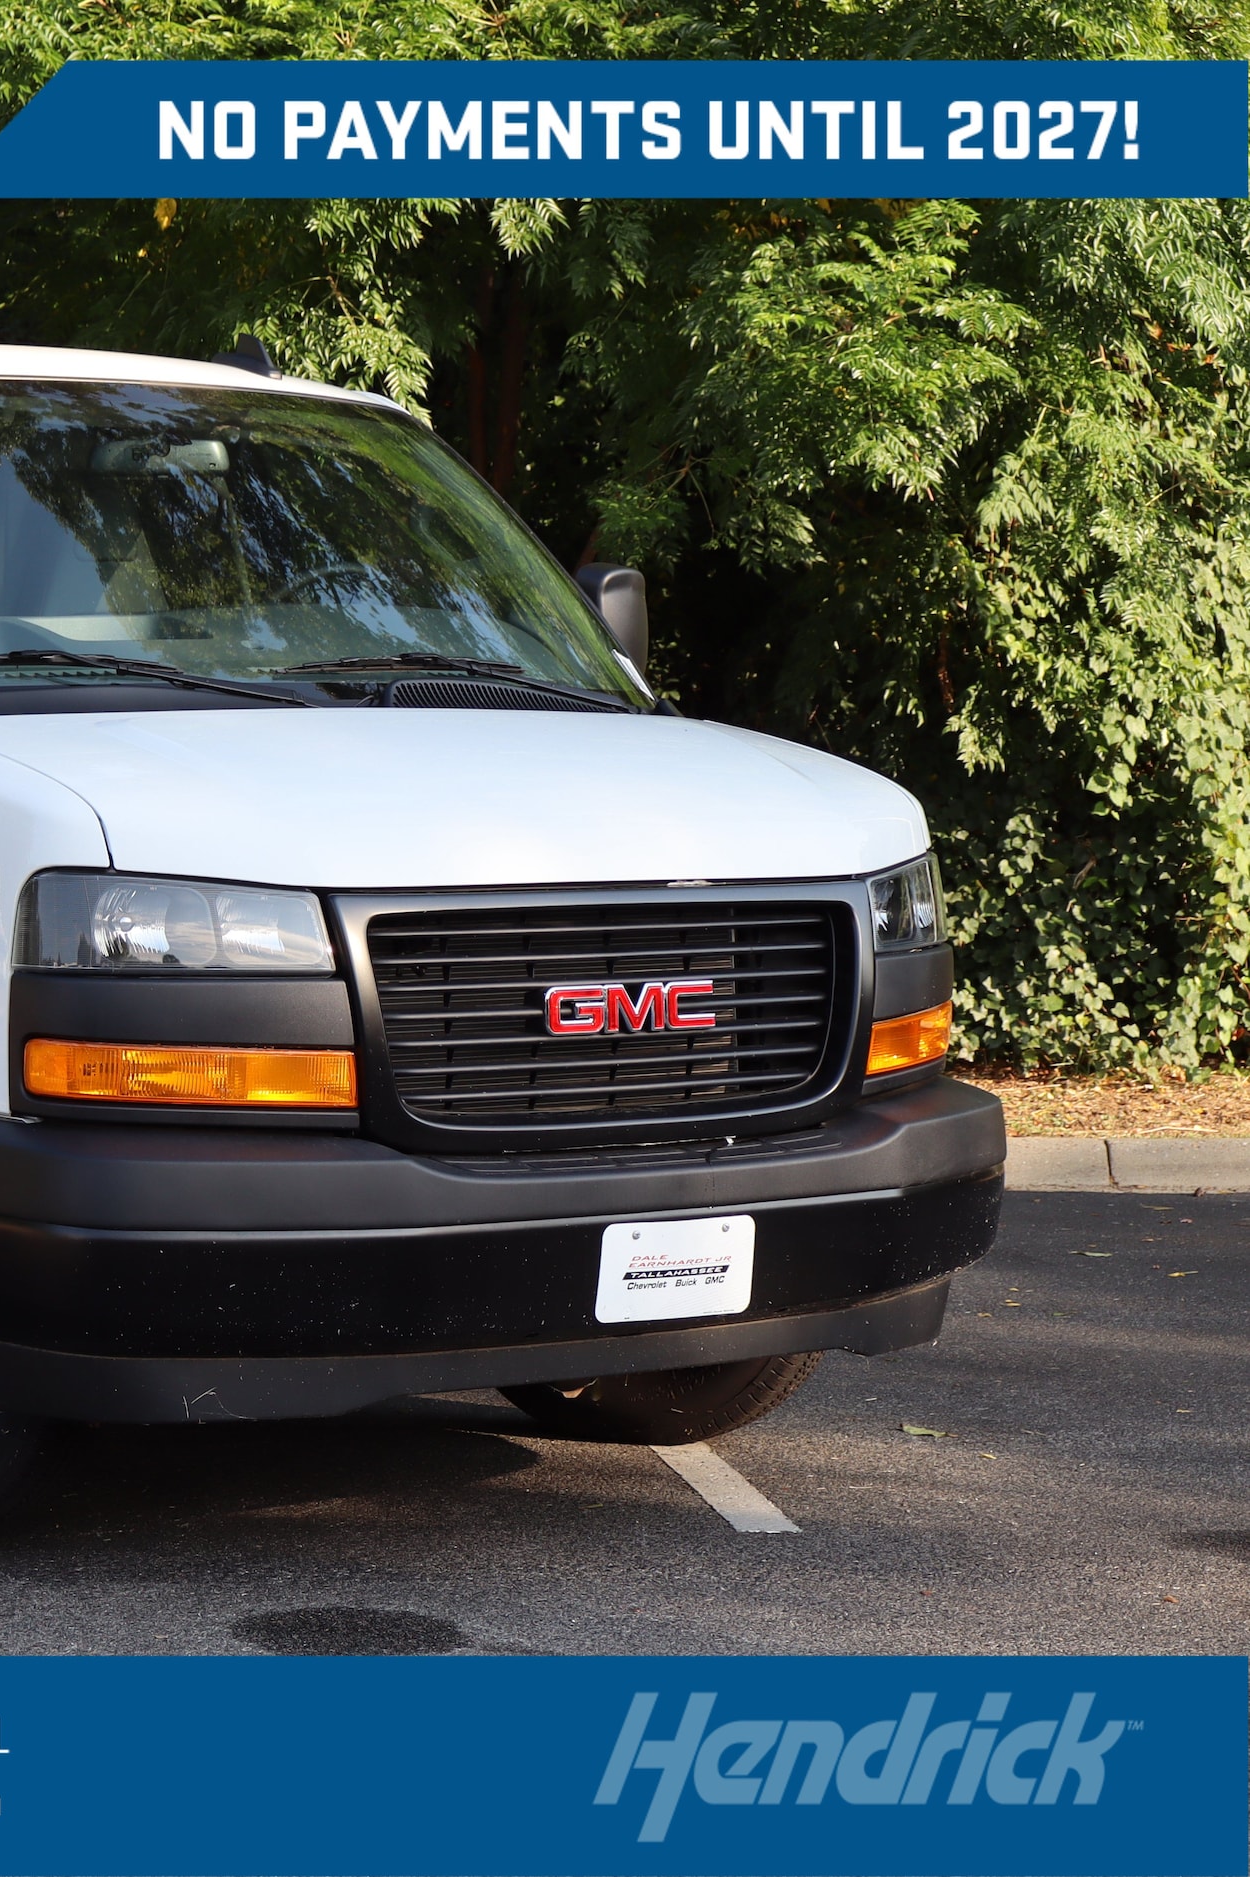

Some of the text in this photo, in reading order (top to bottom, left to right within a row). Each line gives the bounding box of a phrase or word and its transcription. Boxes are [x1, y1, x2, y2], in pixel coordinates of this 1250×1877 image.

[544, 980, 717, 1036] GMC
[628, 1255, 732, 1268] EARNHARDT JR
[632, 1254, 669, 1262] DALE
[630, 1265, 724, 1279] TALLAHASSEE
[626, 1275, 725, 1290] Chevrolet Buick GMC
